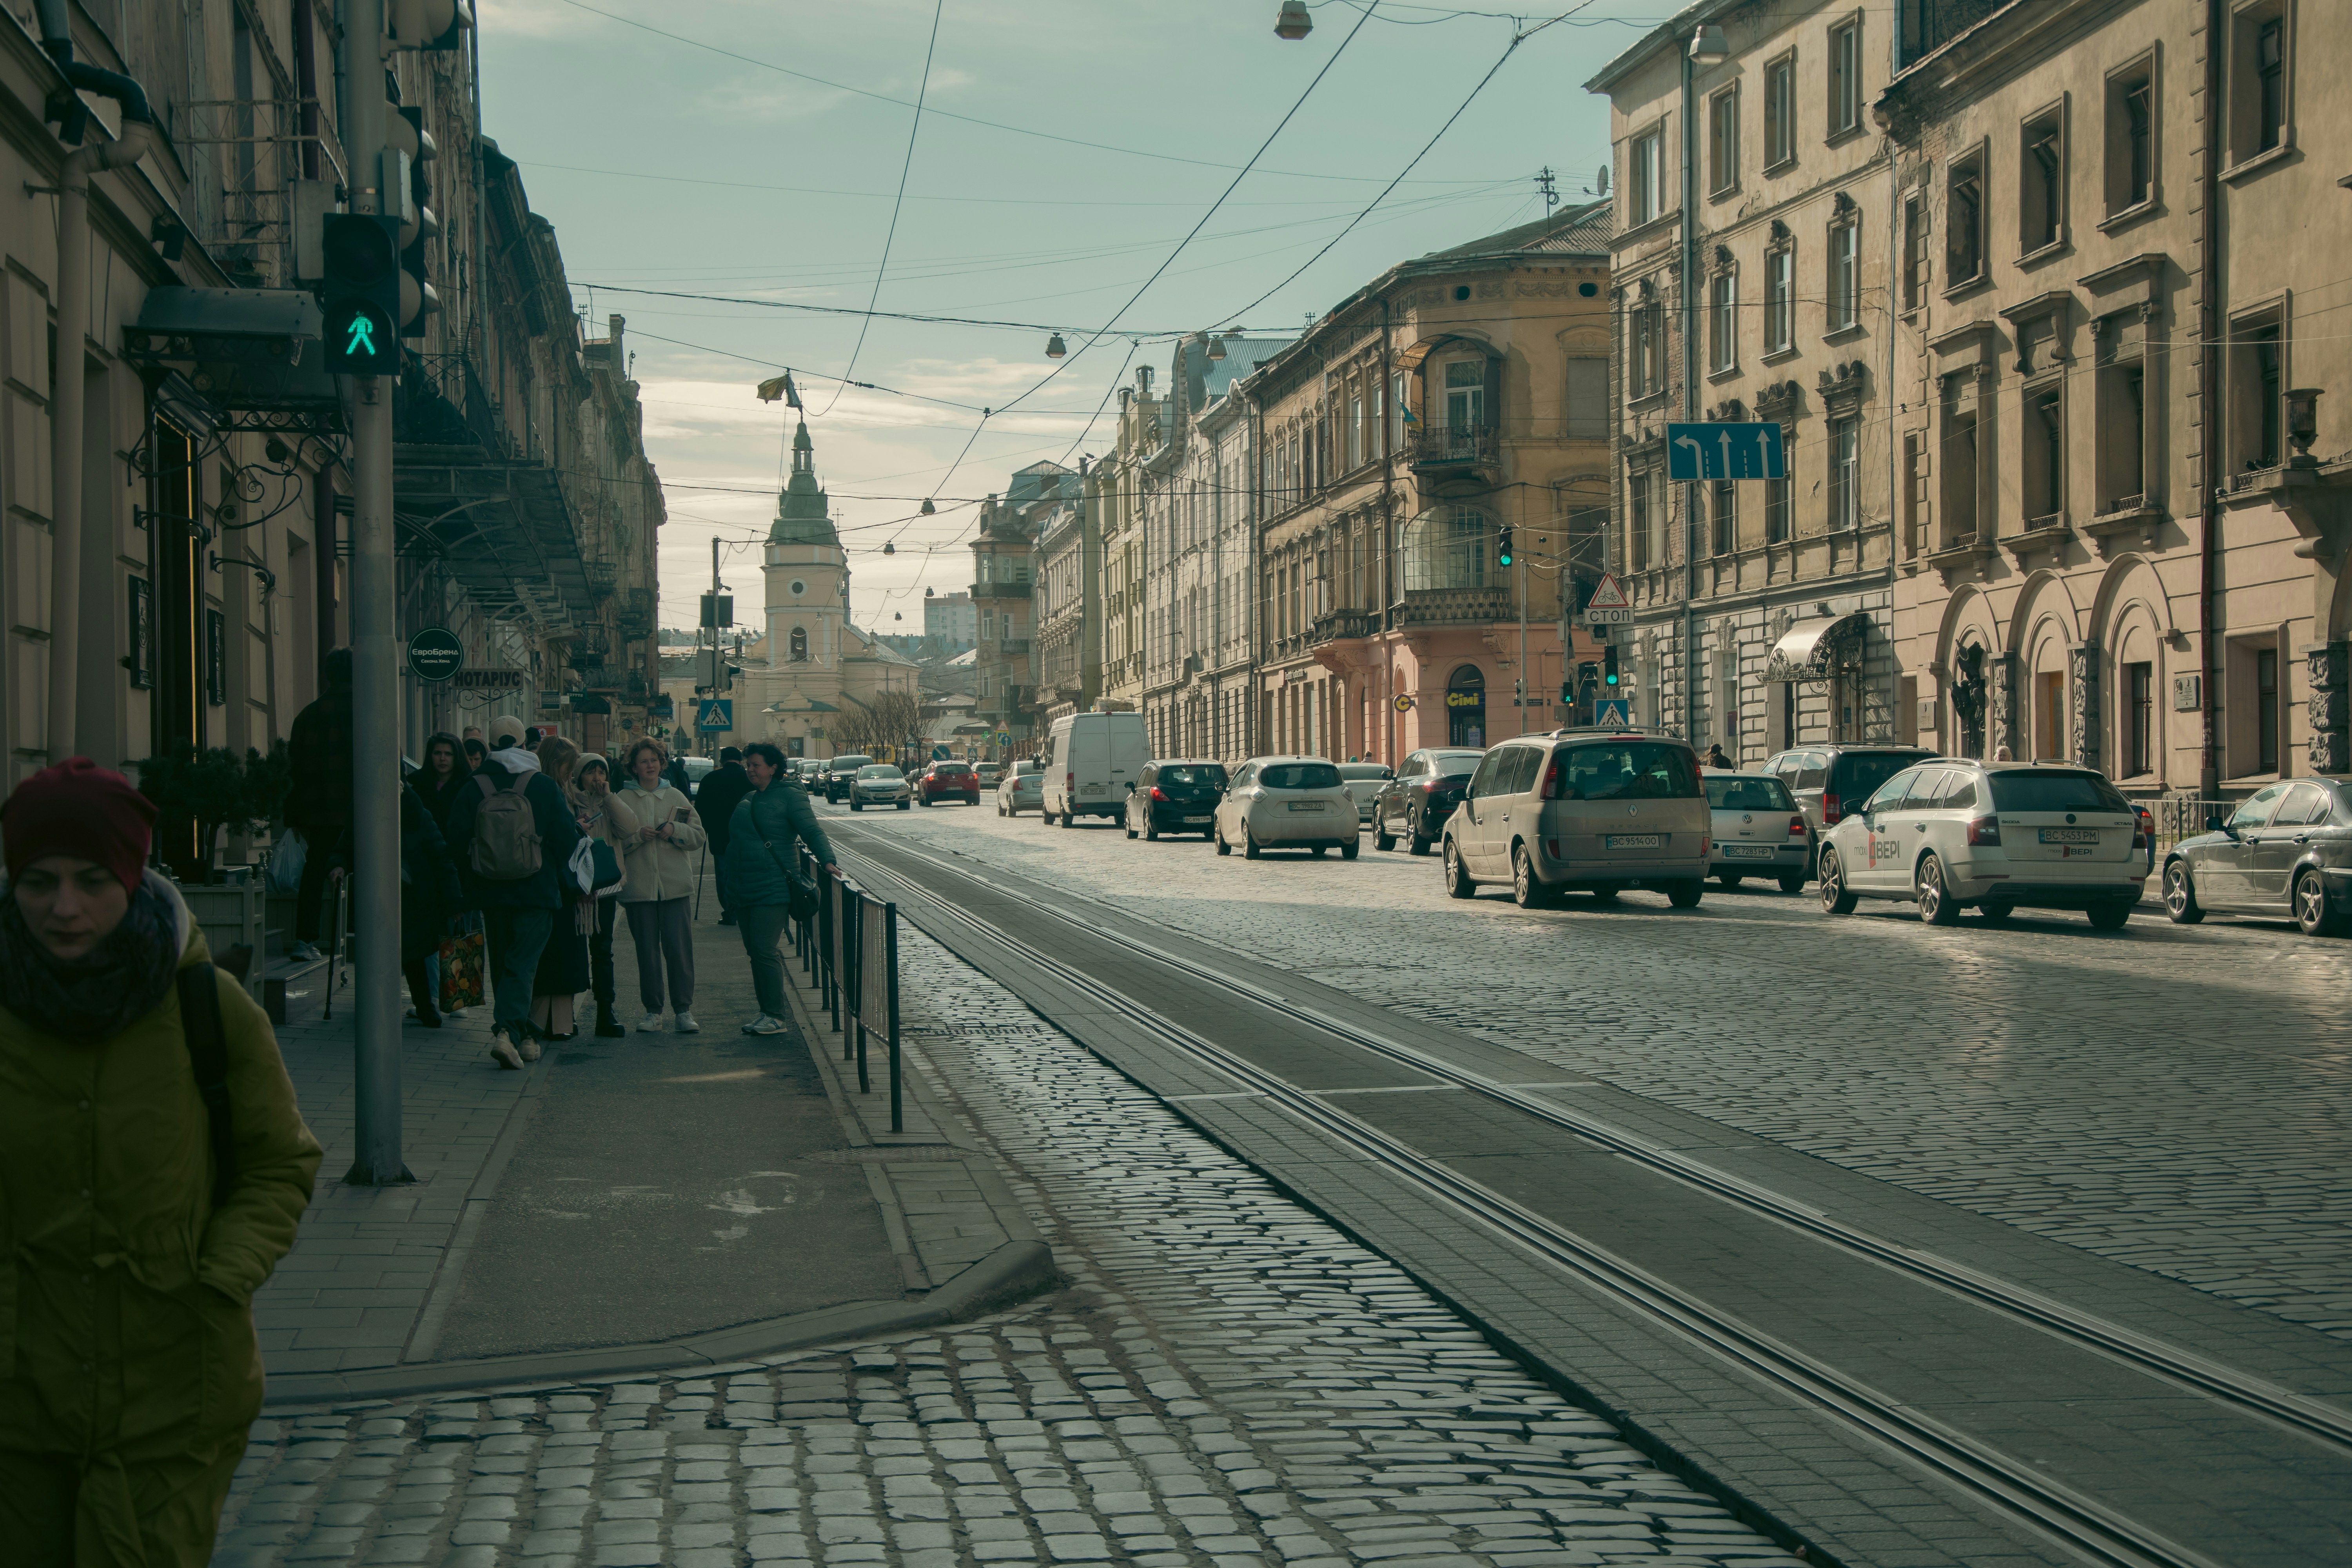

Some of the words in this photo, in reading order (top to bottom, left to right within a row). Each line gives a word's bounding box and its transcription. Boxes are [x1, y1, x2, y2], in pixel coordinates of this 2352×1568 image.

[1590, 610, 1630, 622] СТОП
[455, 671, 521, 686] НОТАРІУС
[2046, 831, 2059, 840] BC
[2061, 831, 2081, 840] 5453
[2083, 831, 2096, 840] PM
[1626, 837, 1644, 845] 9514
[1854, 846, 1868, 855] maxi
